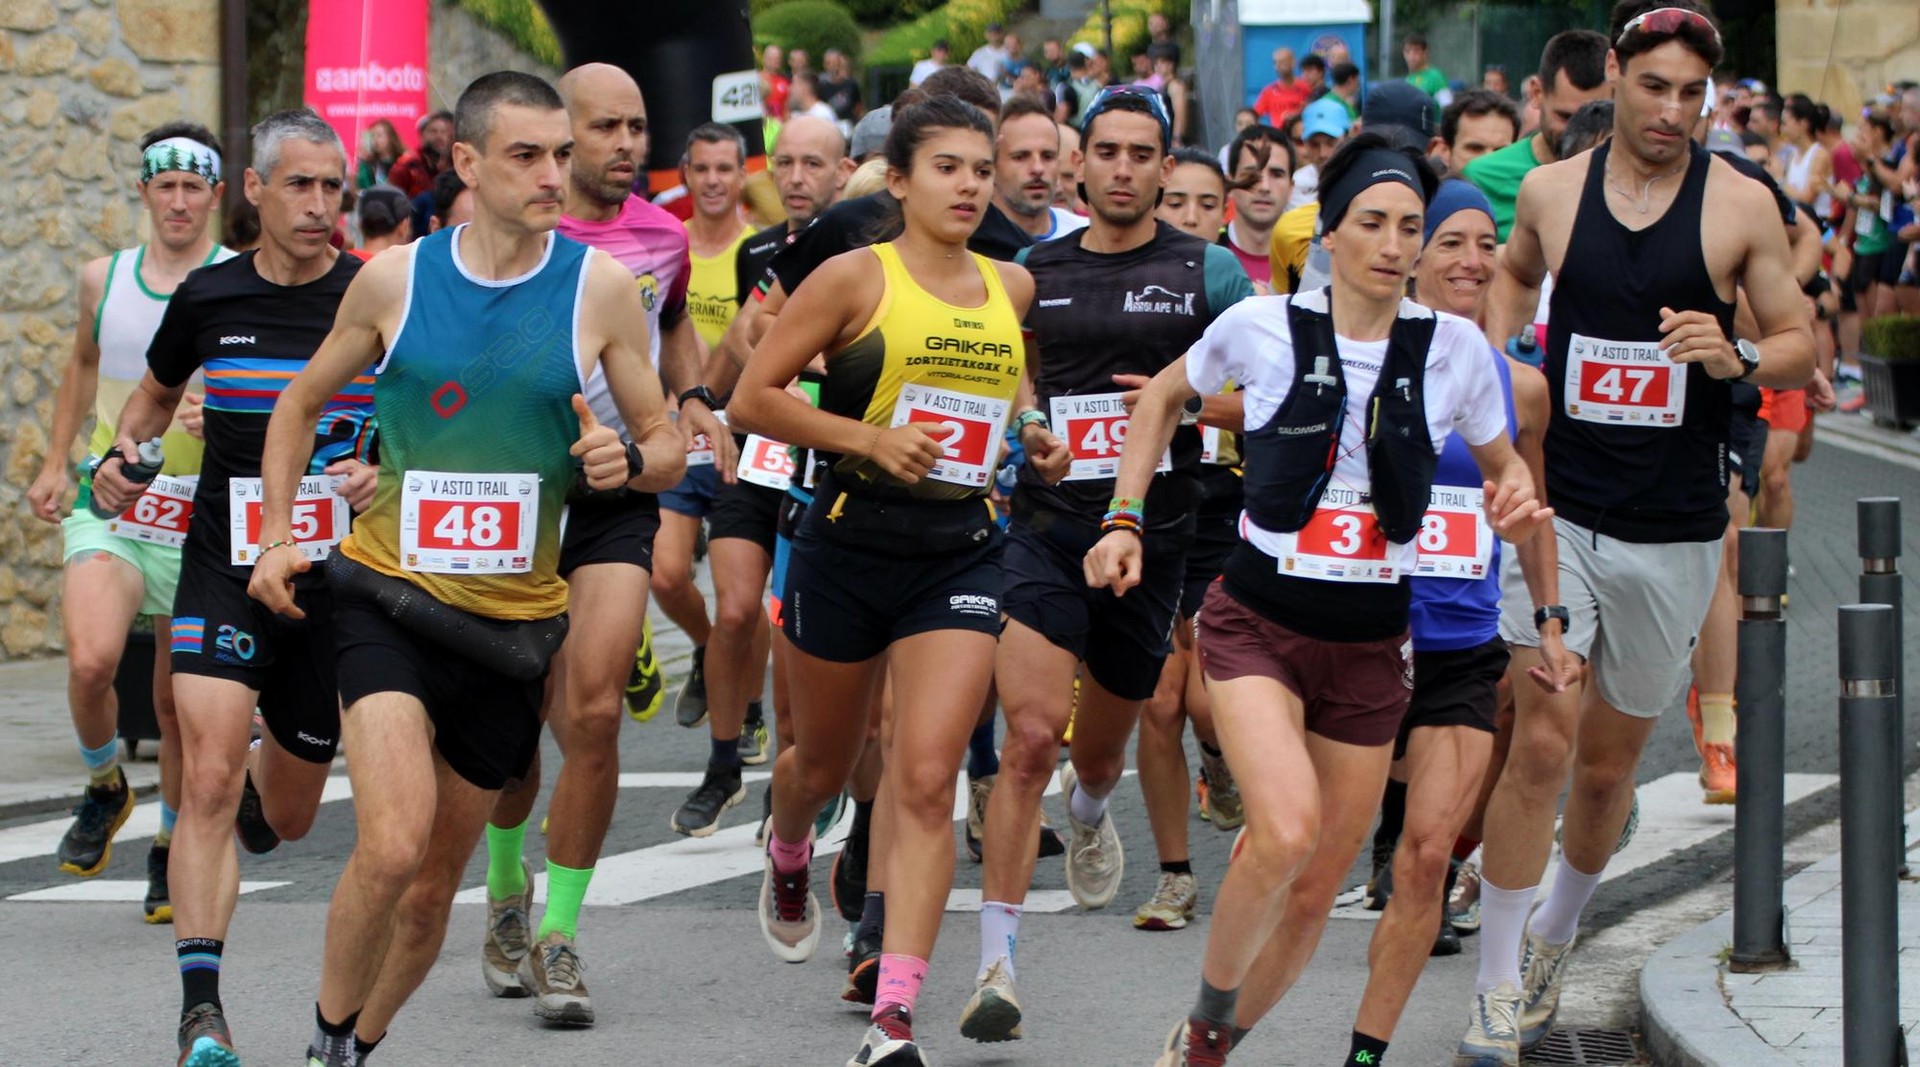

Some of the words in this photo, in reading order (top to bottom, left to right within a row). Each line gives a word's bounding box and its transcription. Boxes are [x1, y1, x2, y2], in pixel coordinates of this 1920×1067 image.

[925, 336, 1012, 359] GAIKAR
[1592, 344, 1599, 357] V
[1601, 345, 1629, 360] ASTO
[1633, 348, 1660, 361] TRAIL
[906, 356, 1002, 373] ZORTZIETAKOAK
[1340, 359, 1382, 373] SALOMO
[1593, 367, 1655, 403] 47
[924, 393, 932, 405] V
[933, 396, 961, 412] ASTO
[962, 401, 987, 417] TRAIL
[1074, 402, 1081, 414] V
[1084, 400, 1109, 413] ASTO
[938, 420, 964, 458] 2
[1081, 419, 1130, 455] 49
[1277, 423, 1327, 435] SALOMON
[150, 480, 168, 492] STO
[170, 484, 191, 497] TRAIL
[300, 482, 322, 495] RAIL
[431, 480, 438, 493] V
[442, 480, 473, 495] ASTO
[476, 481, 509, 496] TRAIL
[1440, 492, 1467, 507] TRAIL
[134, 494, 183, 528] 62
[433, 505, 502, 546] 48
[1329, 514, 1362, 555] 3
[1419, 514, 1448, 552] 8
[950, 595, 997, 609] GAIKAR
[215, 624, 255, 660] 20
